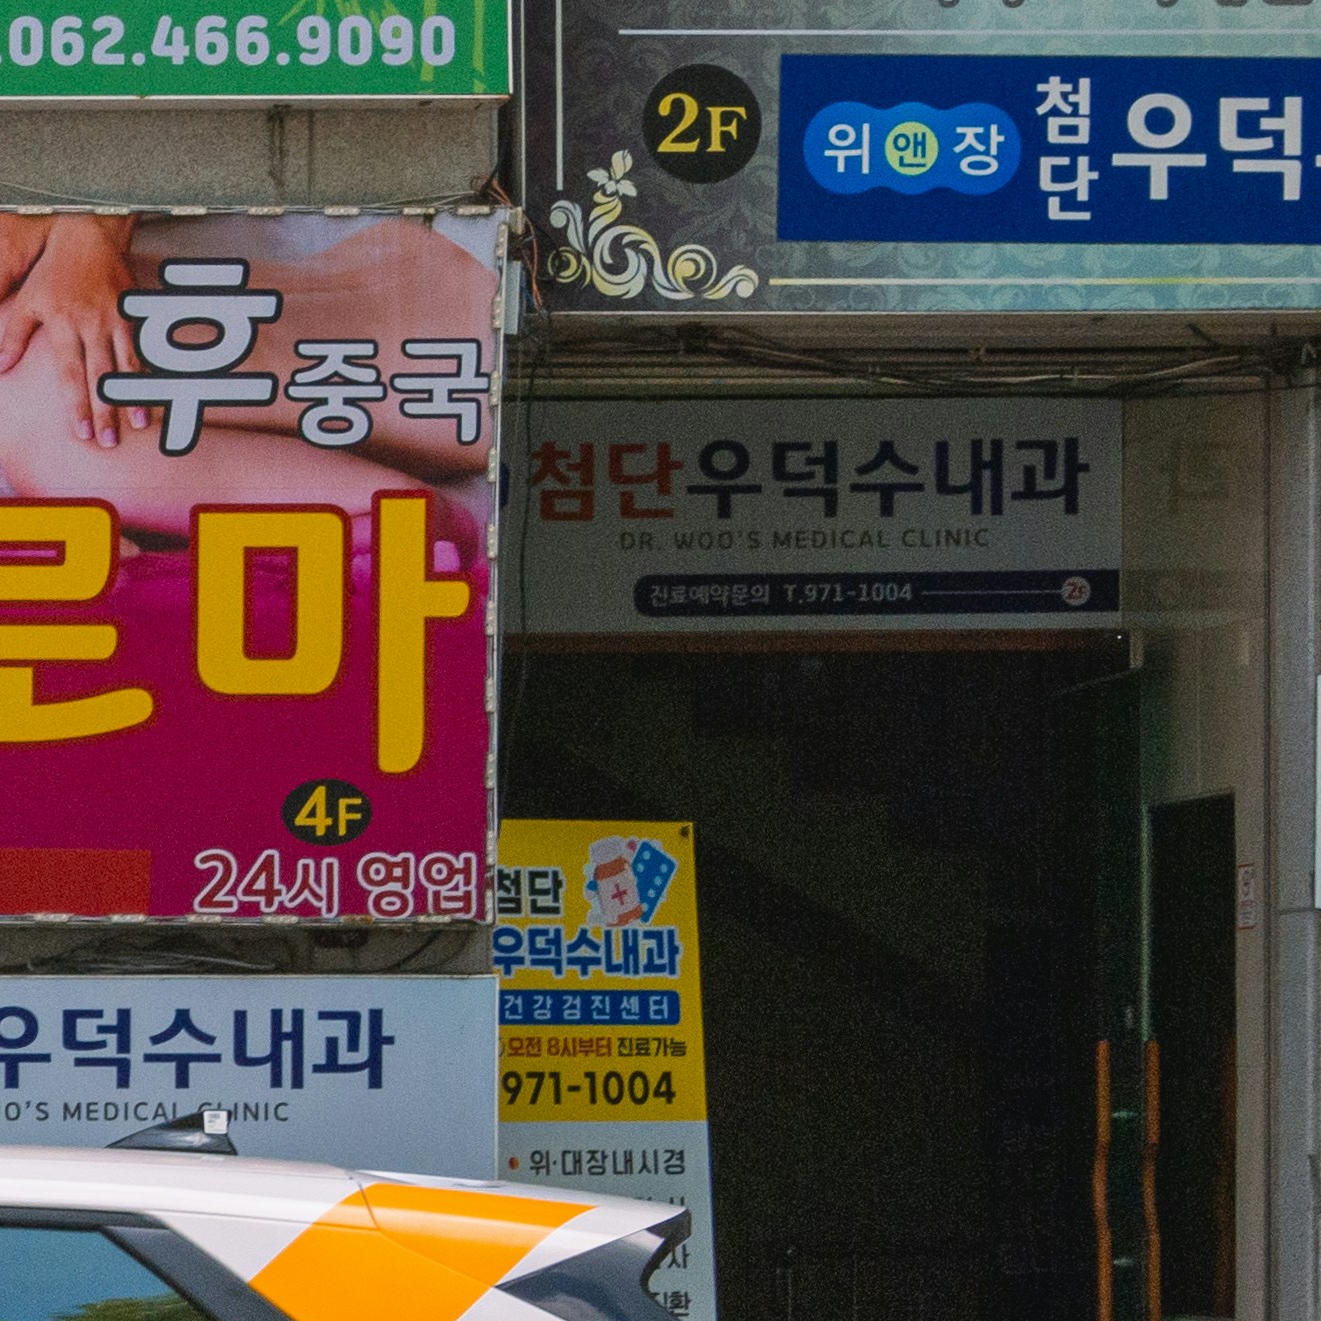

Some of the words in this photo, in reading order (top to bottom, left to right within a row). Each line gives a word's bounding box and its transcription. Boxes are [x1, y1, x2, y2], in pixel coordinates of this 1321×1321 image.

[656, 93, 748, 154] 2F
[1112, 93, 1321, 201] 우덕
[99, 258, 281, 454] 후
[286, 339, 490, 449] 중국
[529, 437, 1091, 522] 첨단우덕수내과
[674, 529, 759, 551] WOO'S
[773, 528, 889, 550] MEDICAL
[903, 528, 989, 549] CLINIC
[783, 582, 913, 604] T.971-1004
[293, 785, 364, 838] 4F
[194, 849, 340, 915] 24시
[358, 851, 479, 917] 영업
[493, 926, 681, 977] 우덕수내과
[504, 995, 669, 1020] 건강검진센터
[509, 1037, 542, 1057] 오전
[547, 1037, 612, 1057] 8시부터
[617, 1037, 686, 1057] 진료가능
[502, 1071, 676, 1105] 971-1004
